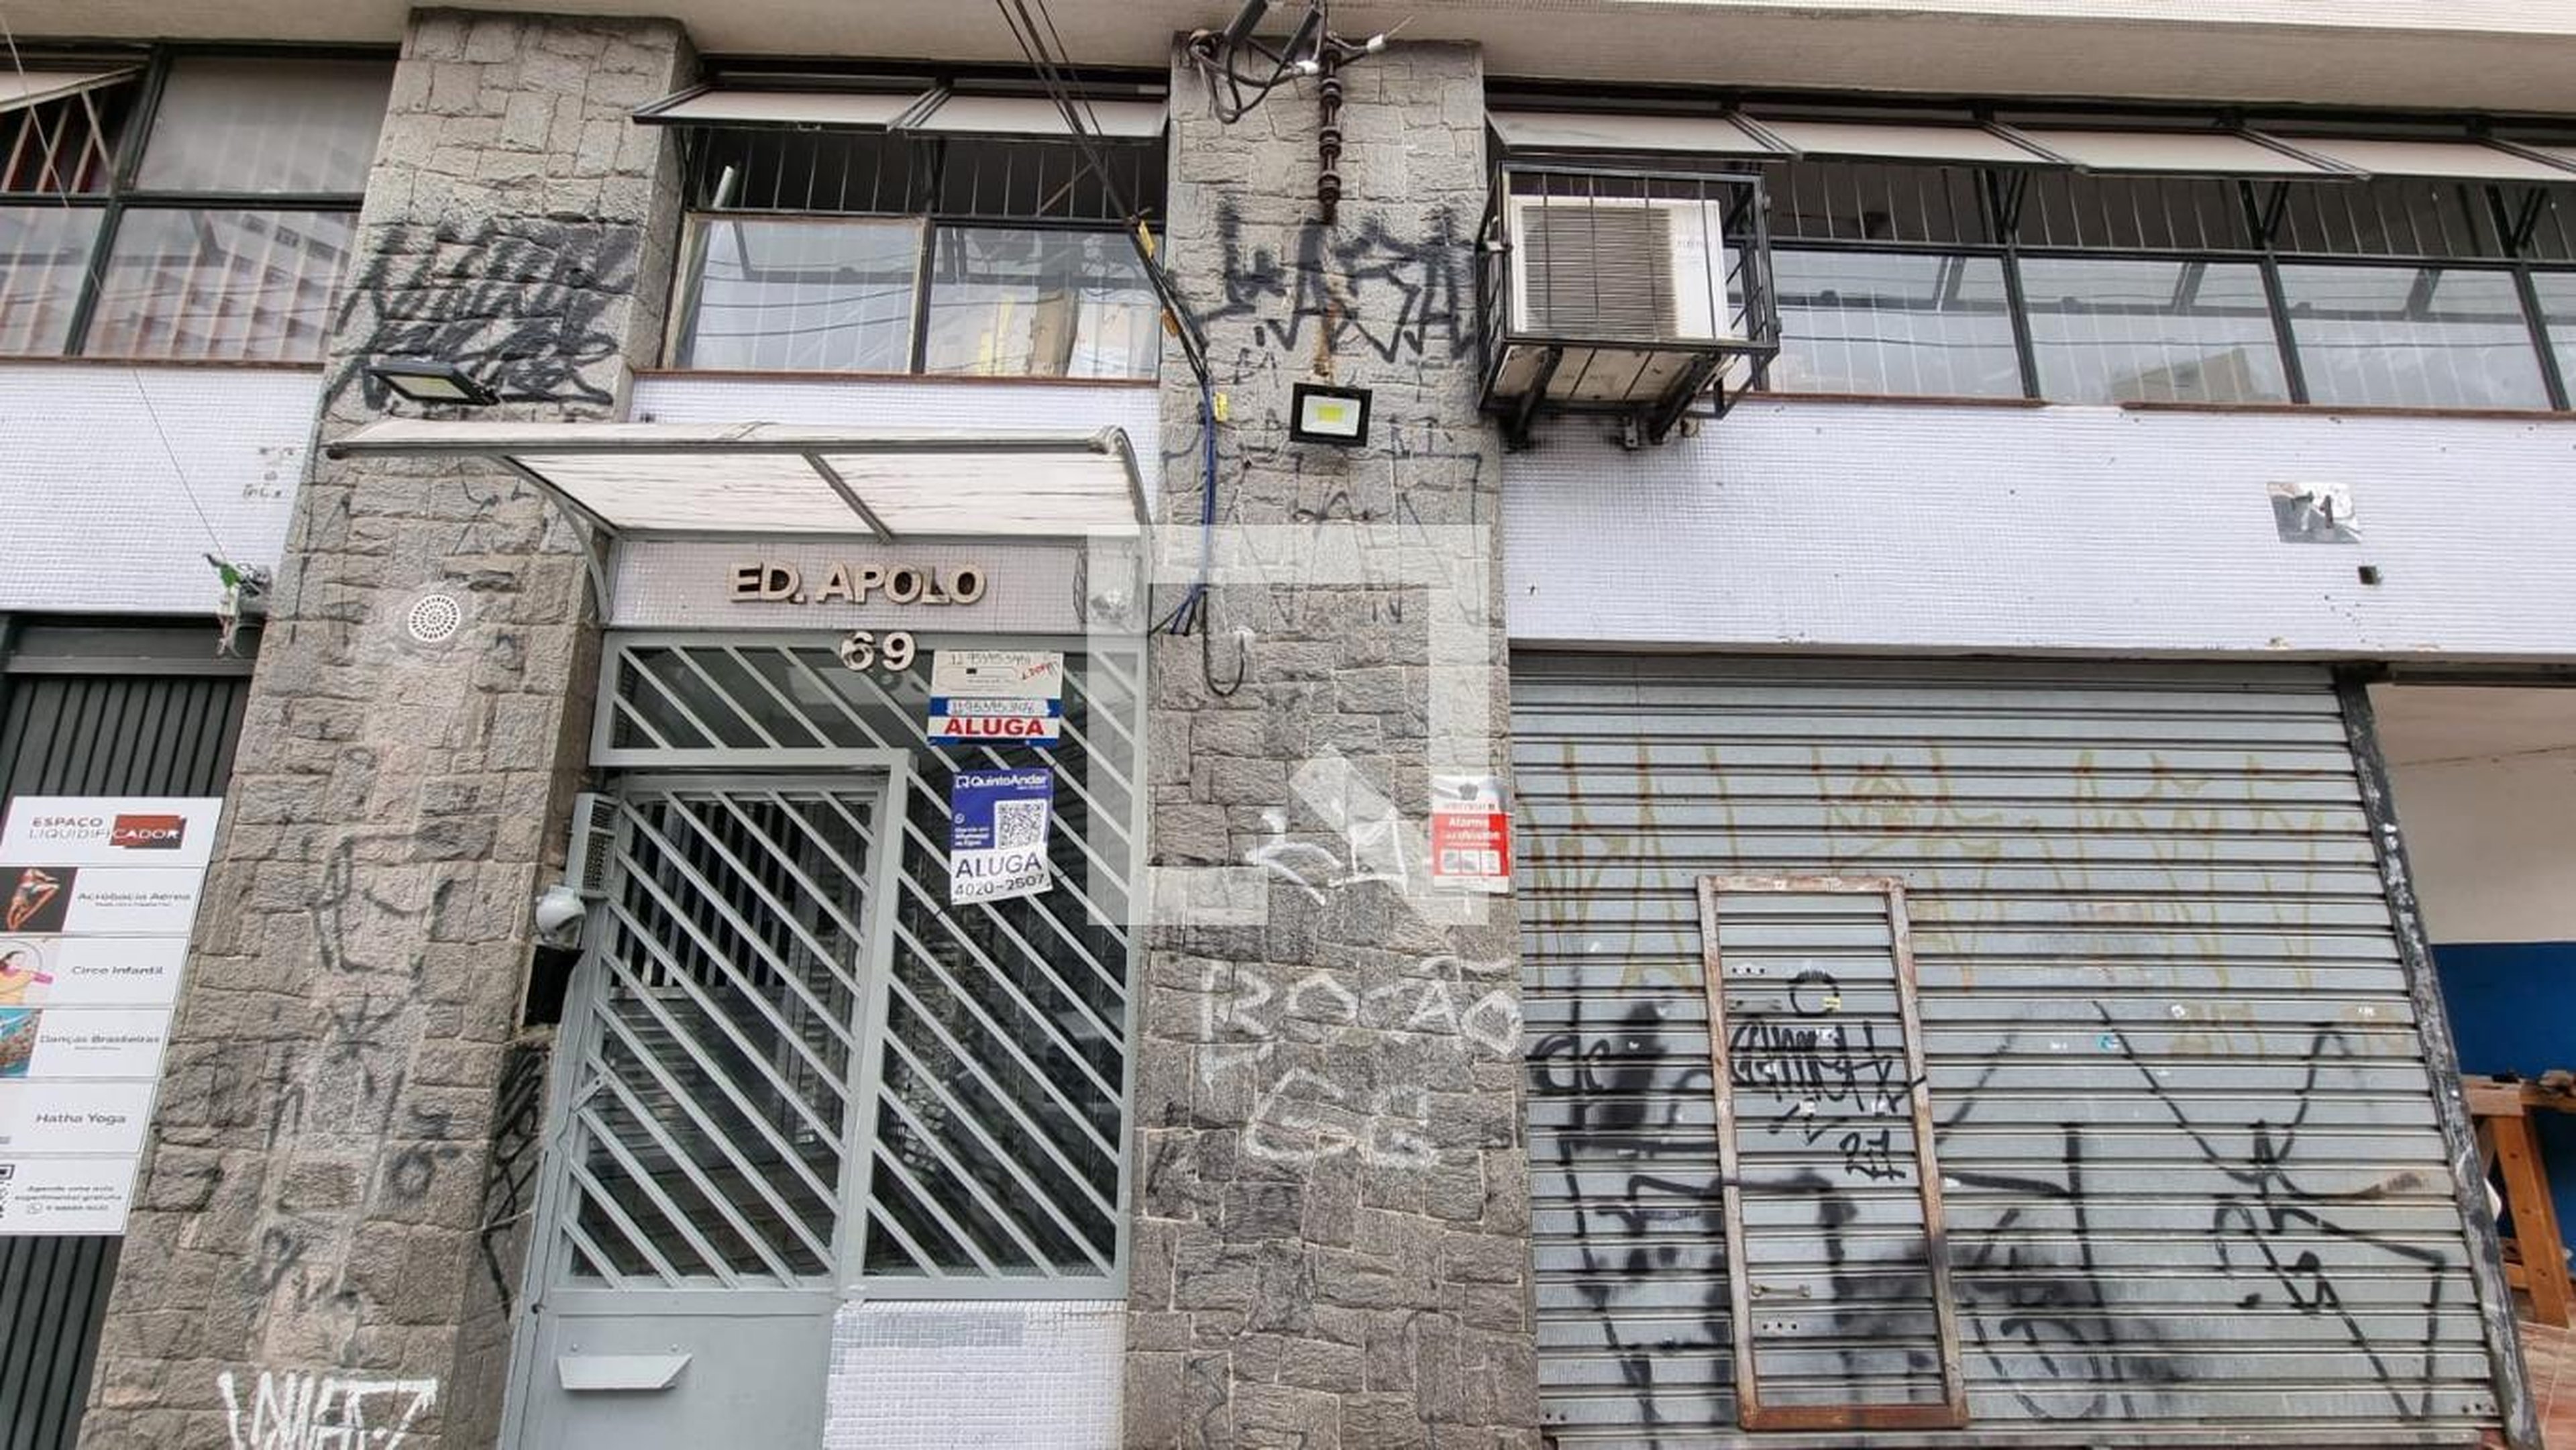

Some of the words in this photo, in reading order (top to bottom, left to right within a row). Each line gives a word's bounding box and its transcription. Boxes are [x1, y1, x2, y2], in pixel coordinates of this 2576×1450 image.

[727, 562, 807, 603] ED.
[815, 561, 987, 605] APOLO
[840, 631, 916, 672] 69
[944, 719, 1044, 735] ALUGA
[971, 774, 1047, 787] QuintoAndar
[29, 828, 180, 839] LIQUIDIFICADOR
[955, 852, 1042, 879] ALUGA
[955, 874, 1044, 896] 4020-2507
[72, 965, 109, 975] Circo
[112, 965, 163, 975] Infantil
[36, 1113, 83, 1123] Hatha
[87, 1113, 127, 1125] Yoga
